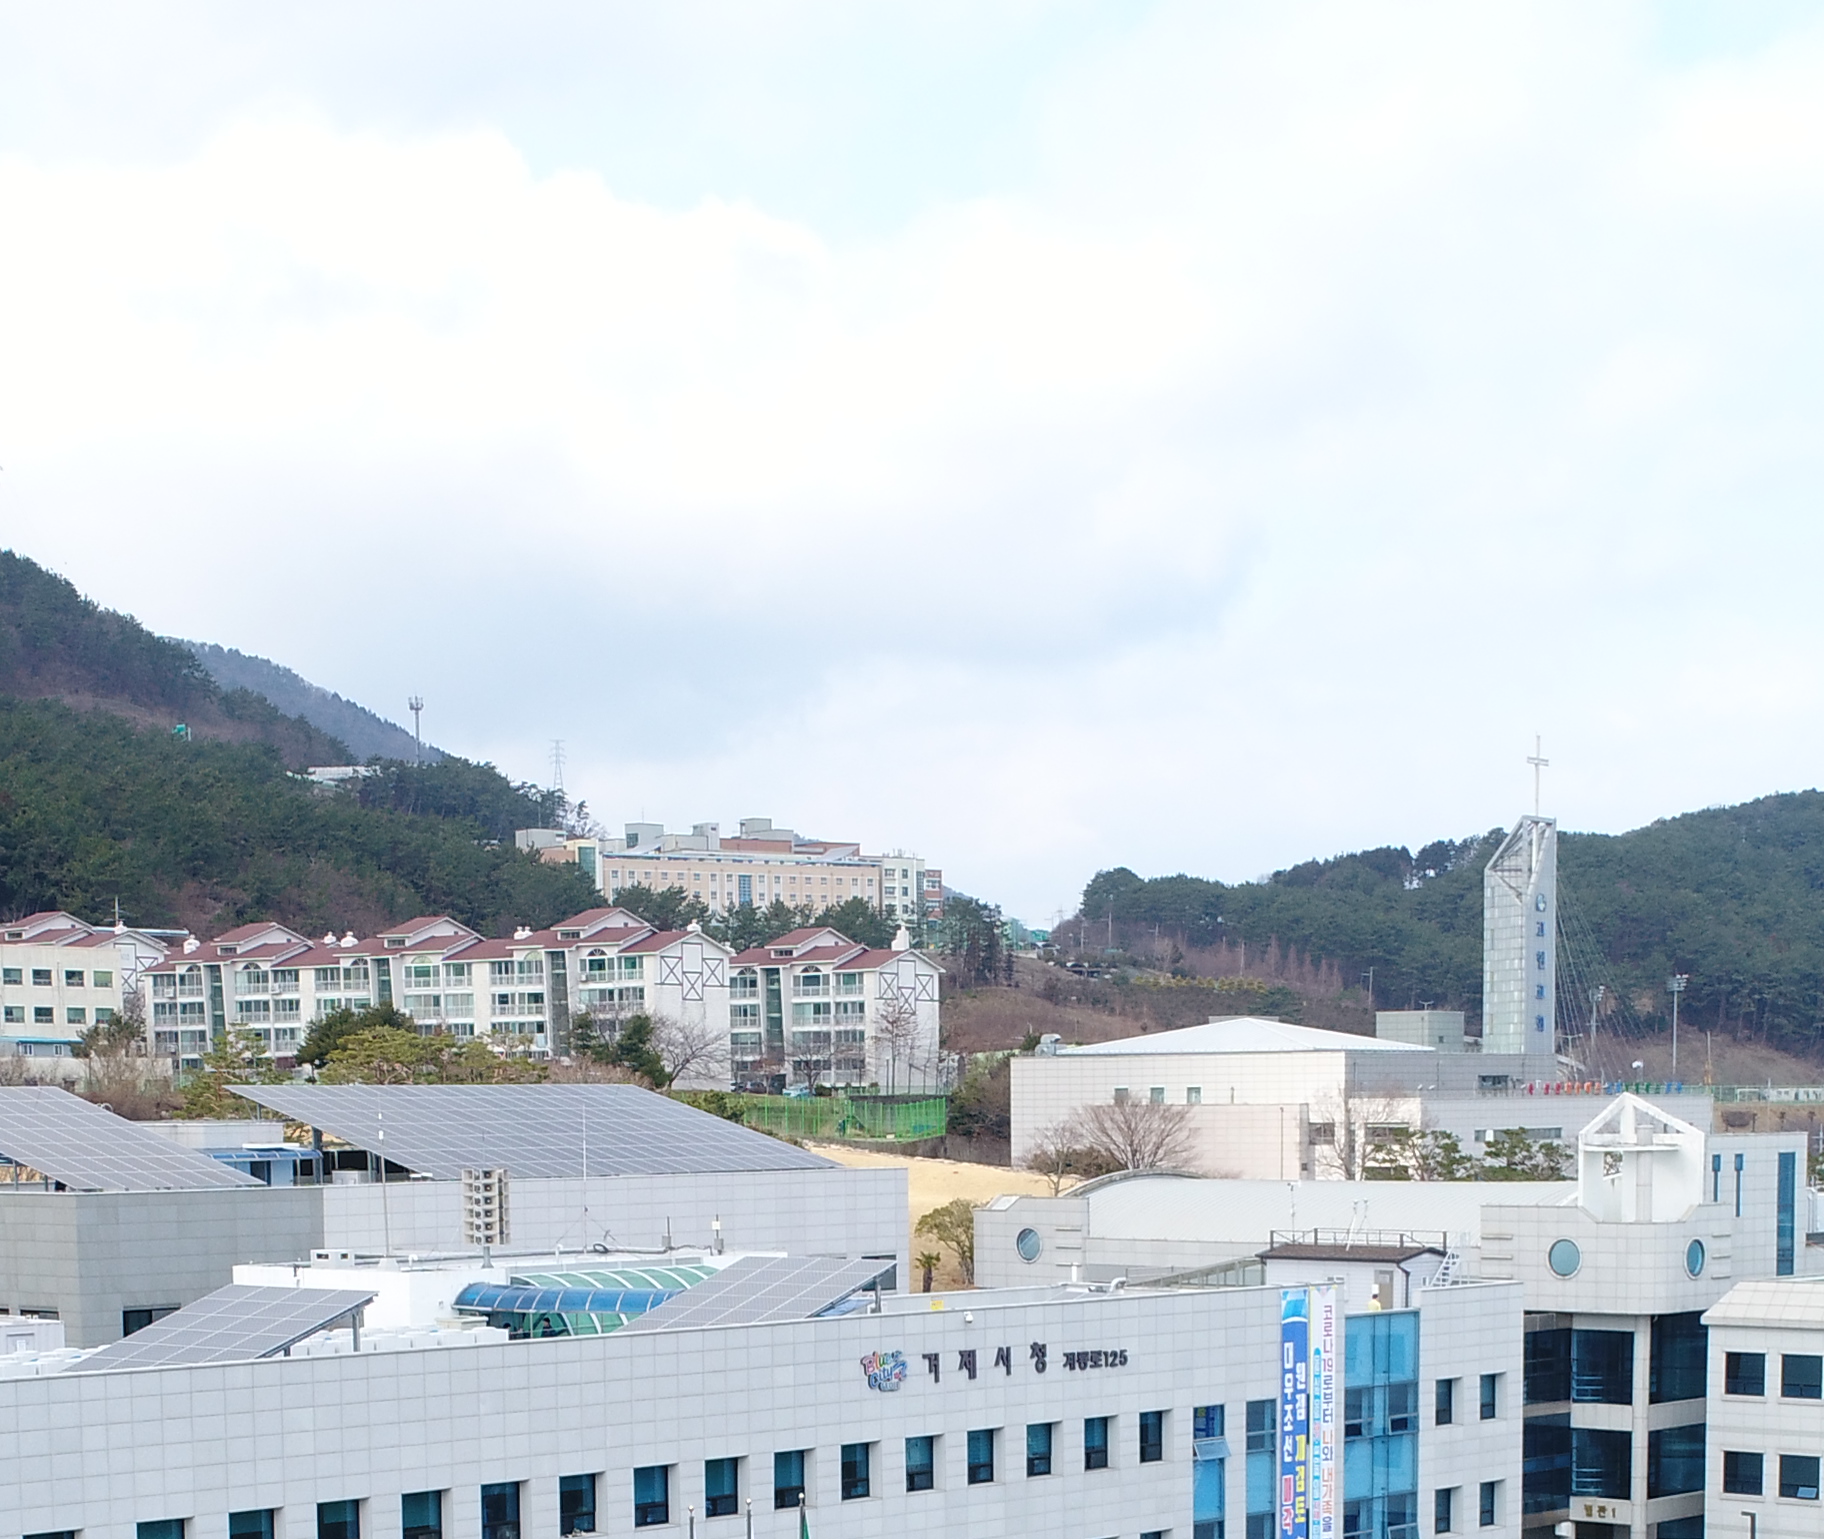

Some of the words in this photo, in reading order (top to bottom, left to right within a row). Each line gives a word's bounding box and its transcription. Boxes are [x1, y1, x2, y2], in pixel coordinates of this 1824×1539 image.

[922, 1342, 1048, 1384] 거제시청
[1322, 1305, 1333, 1424] 코로나19로부터
[1322, 1430, 1333, 1462] 나와
[1321, 1467, 1333, 1533] 내가족을
